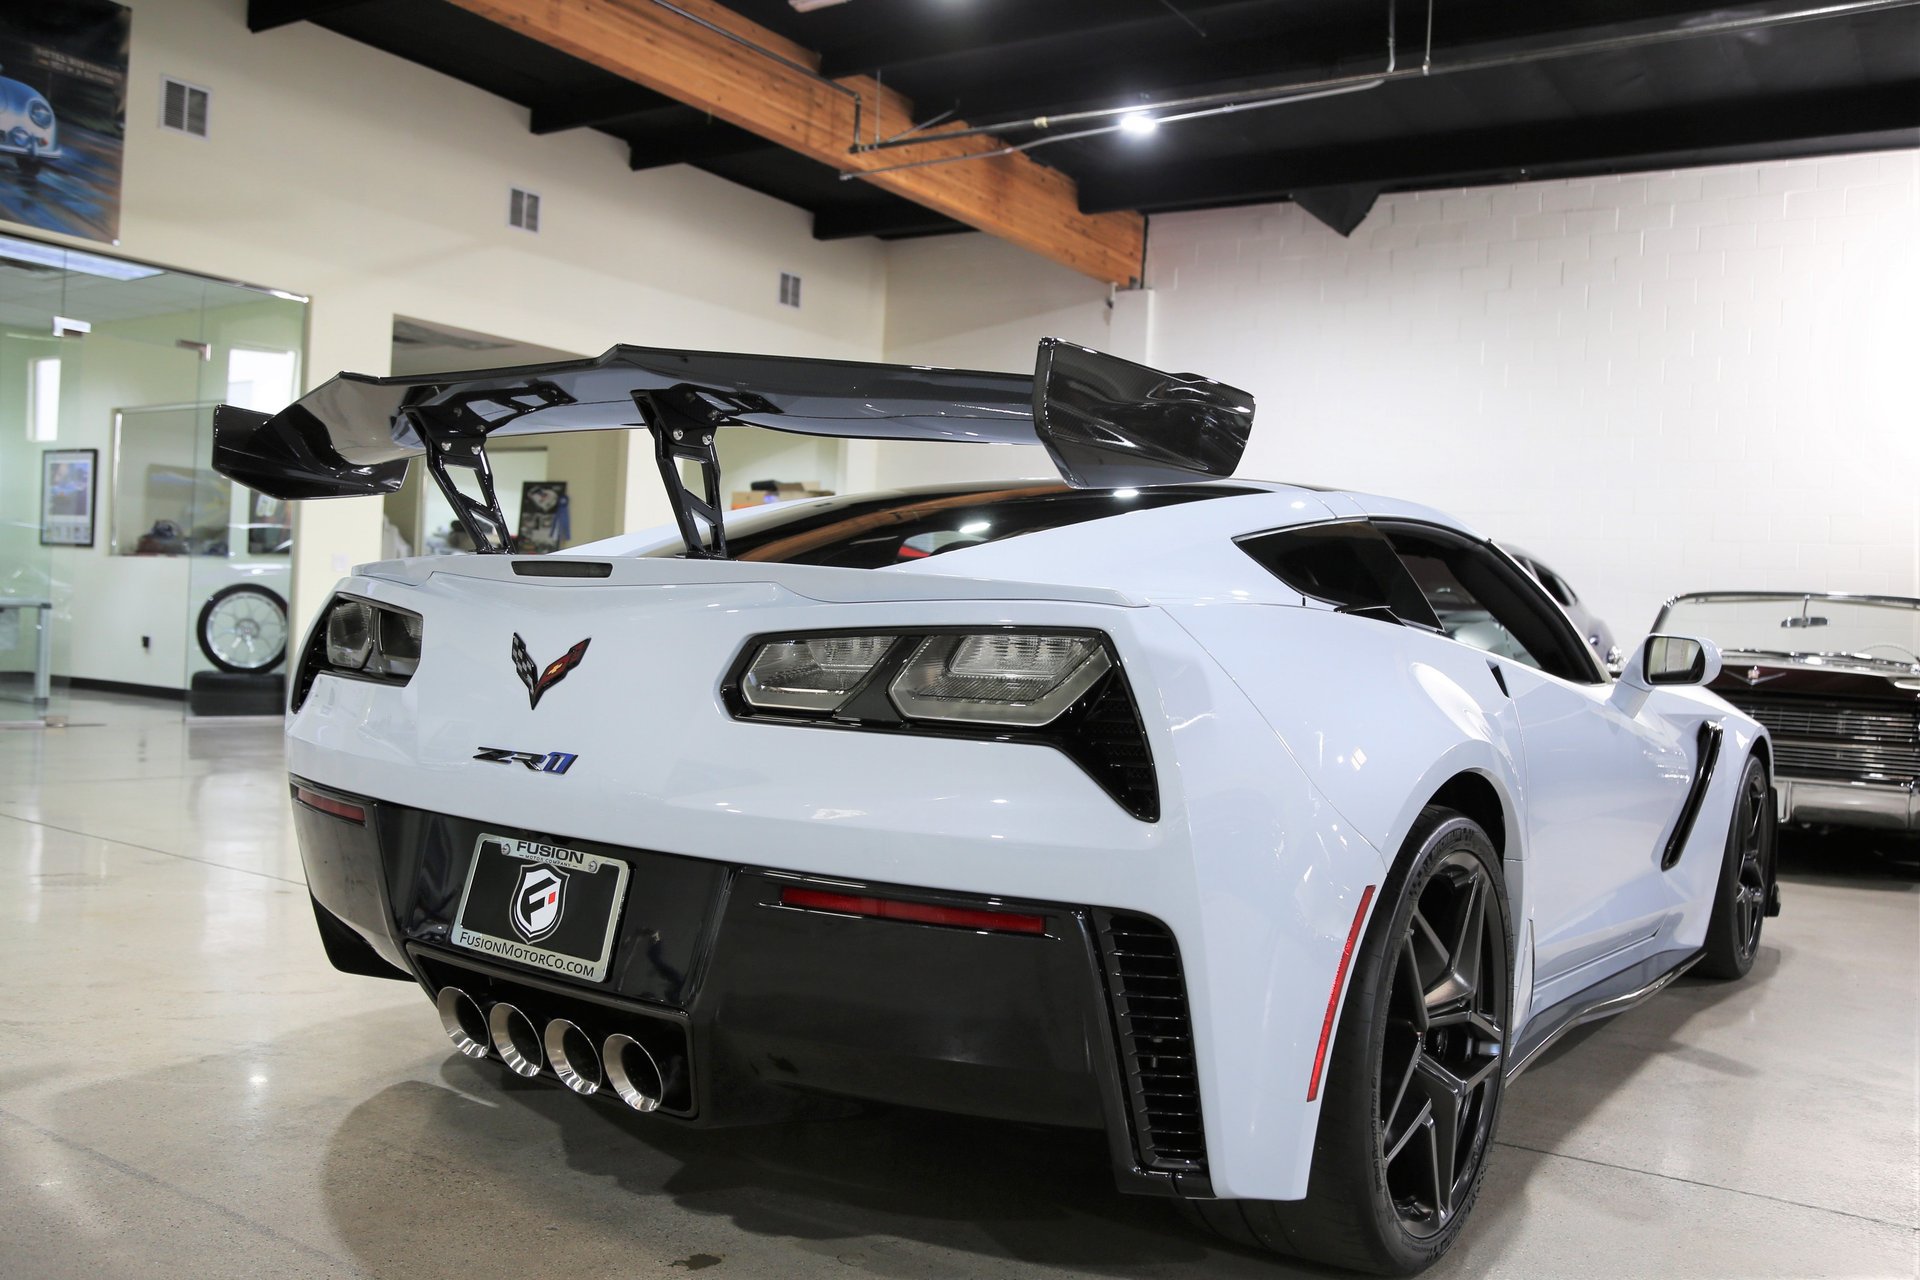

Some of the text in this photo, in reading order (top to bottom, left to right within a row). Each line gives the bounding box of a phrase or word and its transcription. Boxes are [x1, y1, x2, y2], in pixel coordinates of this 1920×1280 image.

[473, 746, 579, 775] ZR1
[516, 841, 584, 864] FUSION
[525, 854, 571, 867] MOTOR COMPANY
